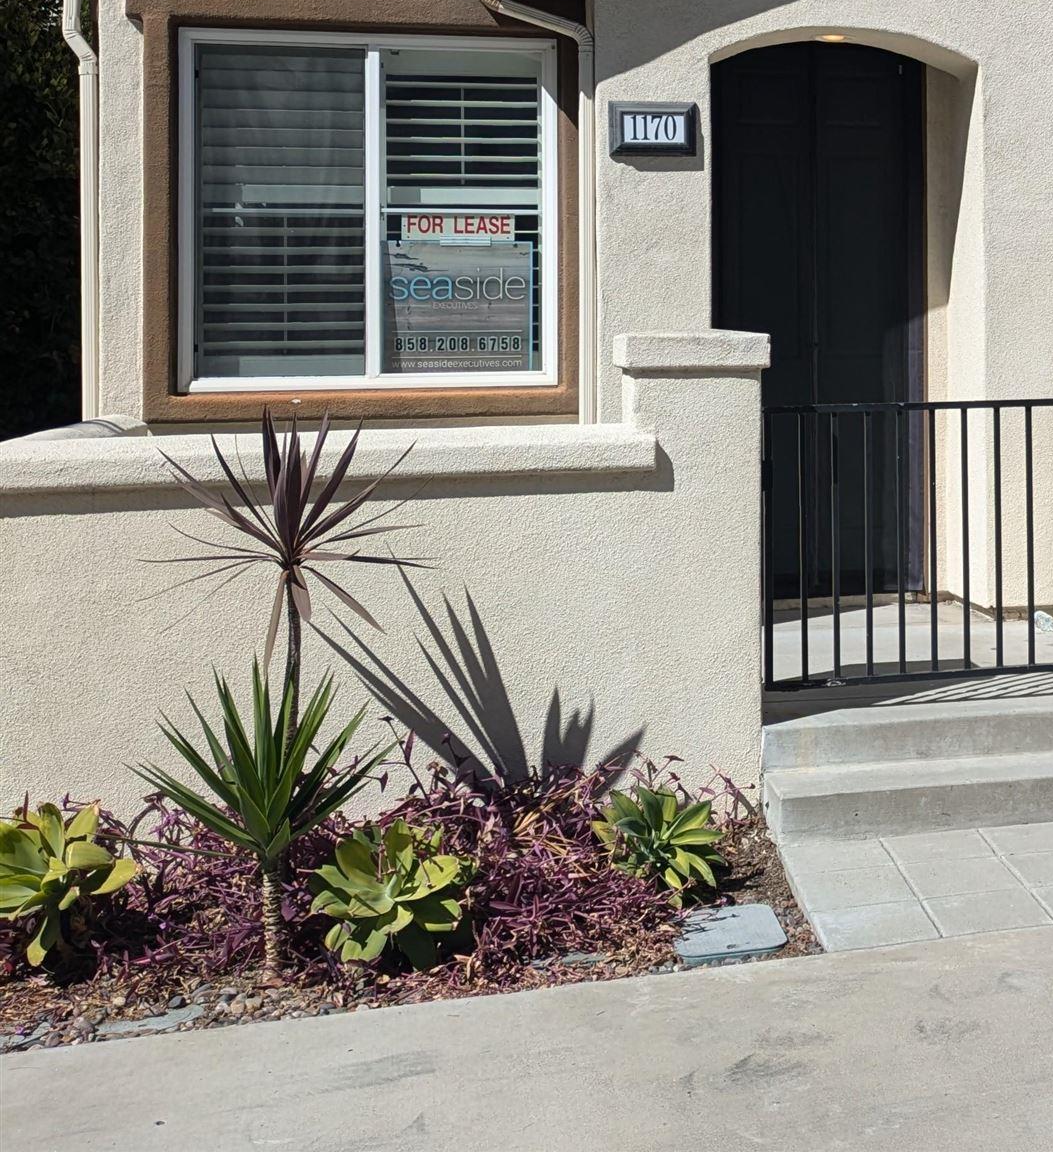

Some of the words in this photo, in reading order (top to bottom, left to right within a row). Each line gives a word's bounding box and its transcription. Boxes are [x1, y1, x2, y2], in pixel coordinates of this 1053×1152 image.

[630, 114, 677, 140] 1170
[407, 215, 444, 234] FOR
[454, 215, 511, 235] LEASE
[390, 267, 526, 300] seaside
